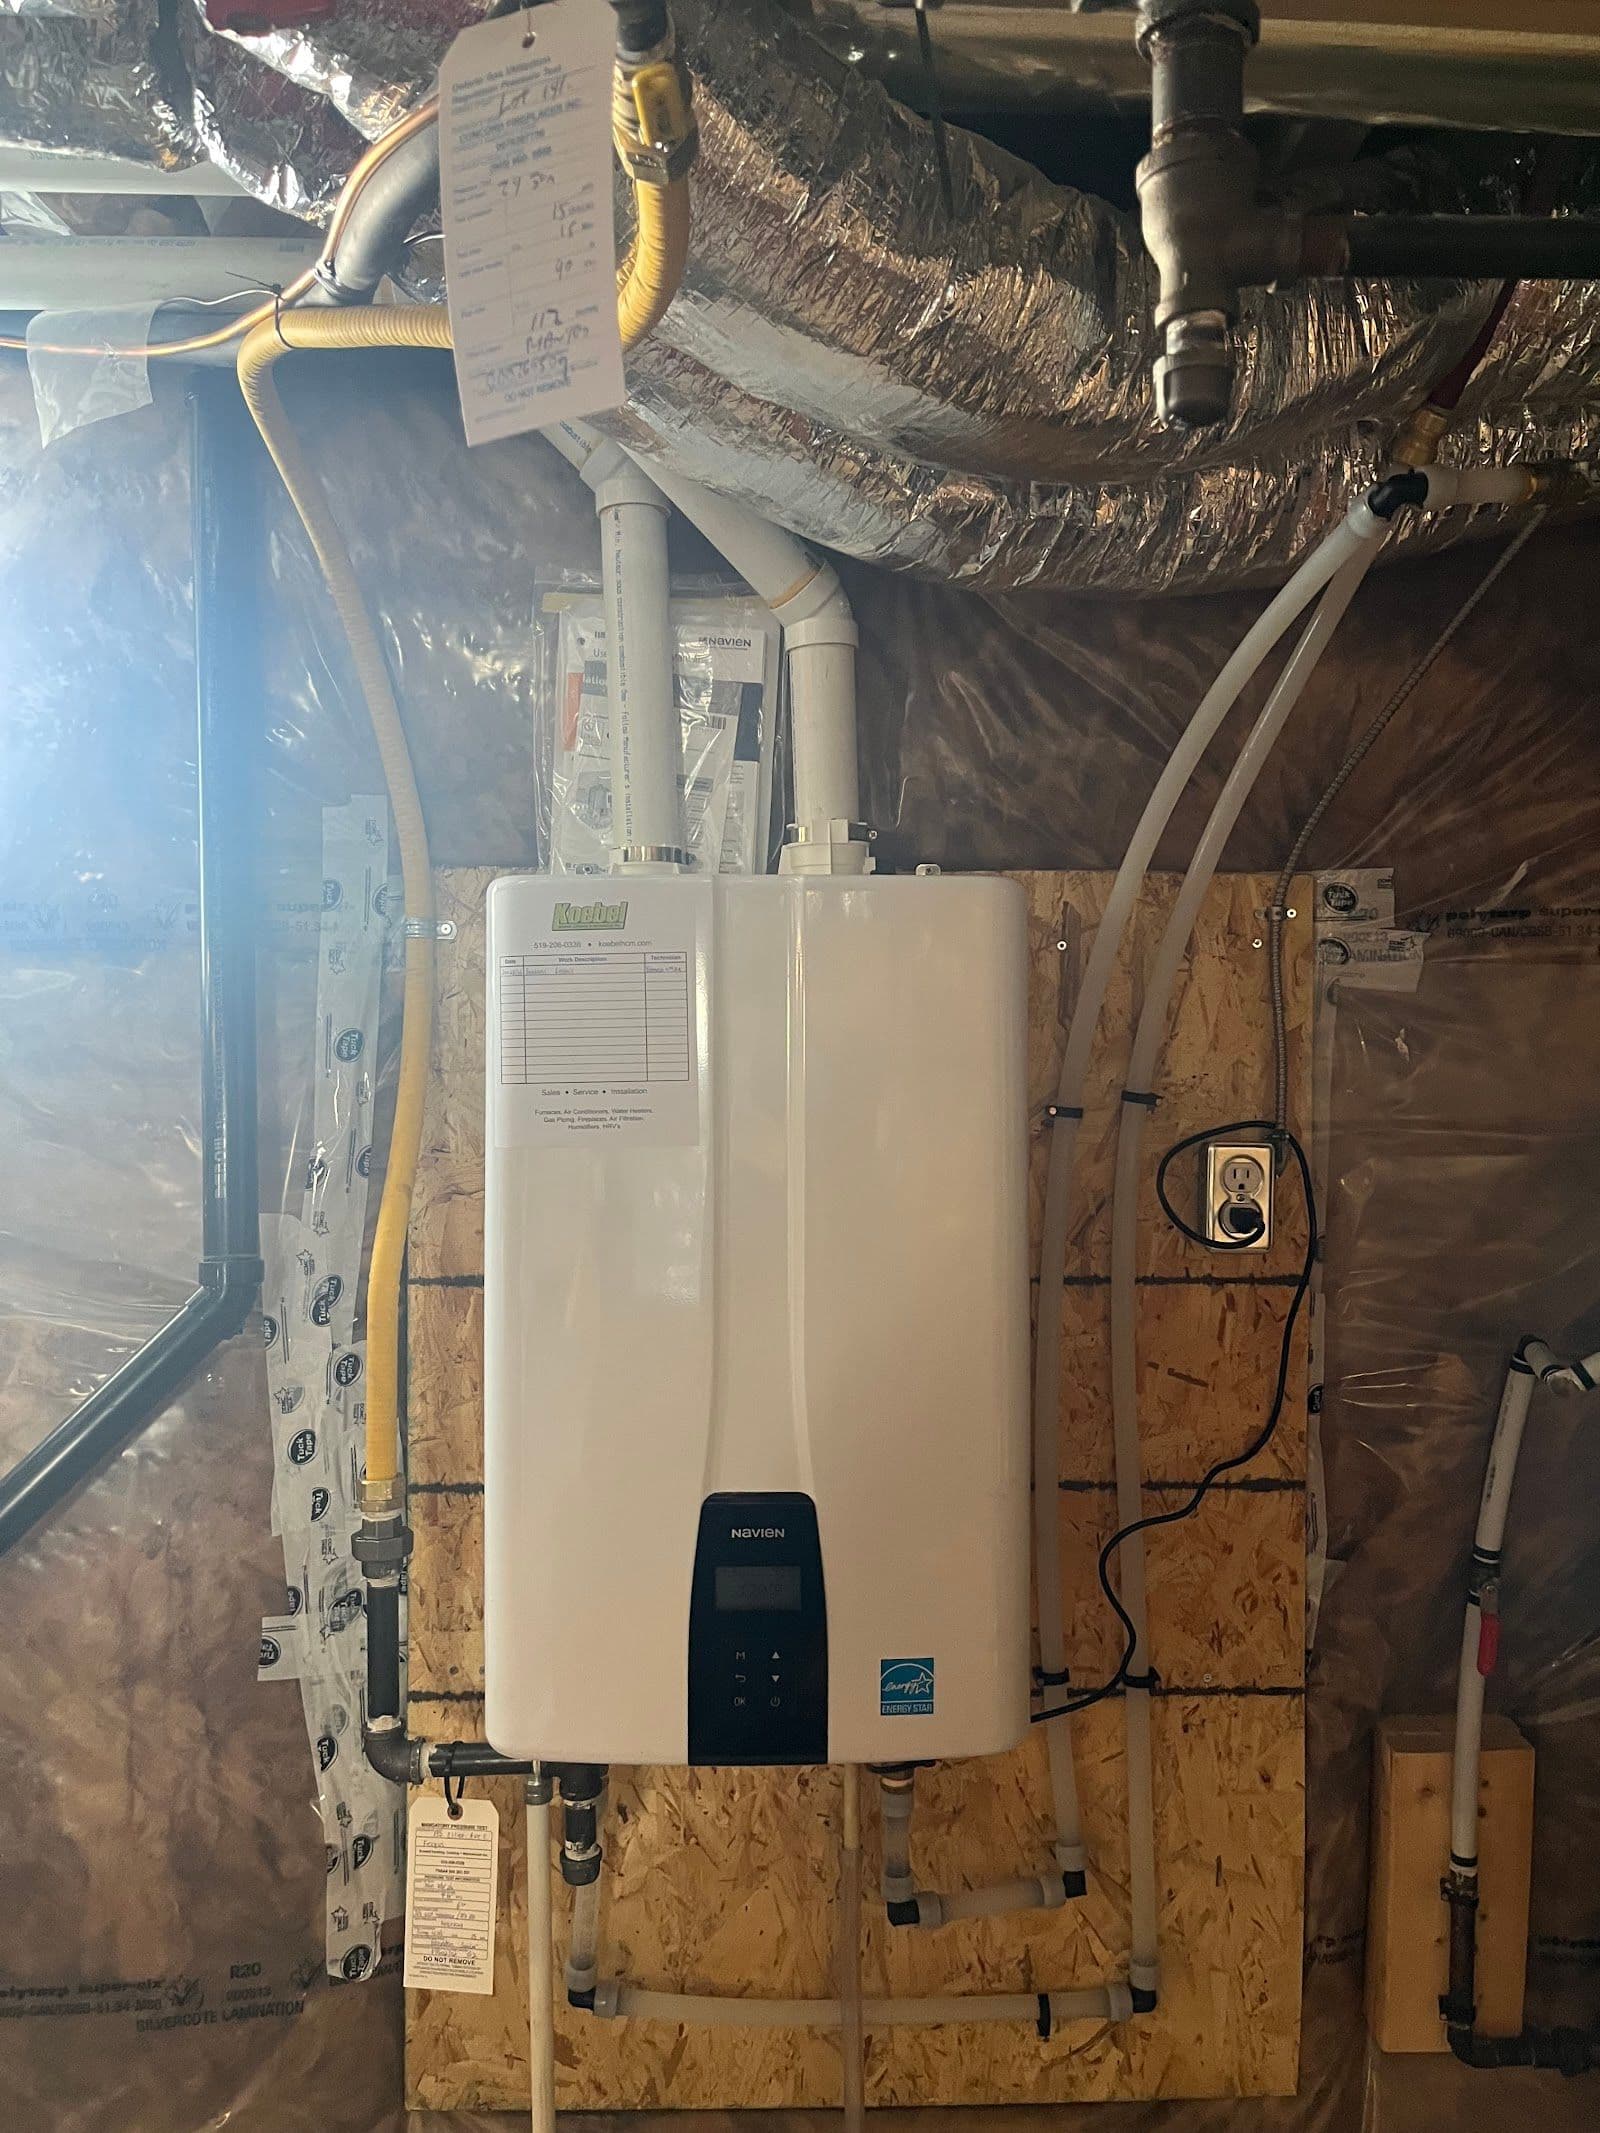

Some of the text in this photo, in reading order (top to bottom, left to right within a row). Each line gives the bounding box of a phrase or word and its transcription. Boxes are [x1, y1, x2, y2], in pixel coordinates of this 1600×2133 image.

[553, 901, 628, 925] Koebel
[349, 1032, 360, 1056] Tuck
[572, 1088, 599, 1096] Service
[340, 1359, 348, 1382] Tape
[347, 1356, 355, 1380] Tuck
[296, 1436, 305, 1462] Tuck
[305, 1433, 313, 1457] Tape
[315, 1491, 324, 1514] Tuck
[735, 1651, 746, 1661] M
[734, 1696, 746, 1707] OK
[881, 1703, 932, 1714] ENERGY STAR
[321, 1739, 329, 1763] Tuck
[355, 1838, 364, 1863] Tuck
[423, 1955, 476, 1966] DO NOT REMOVE
[221, 1999, 305, 2023] LAMINATION
